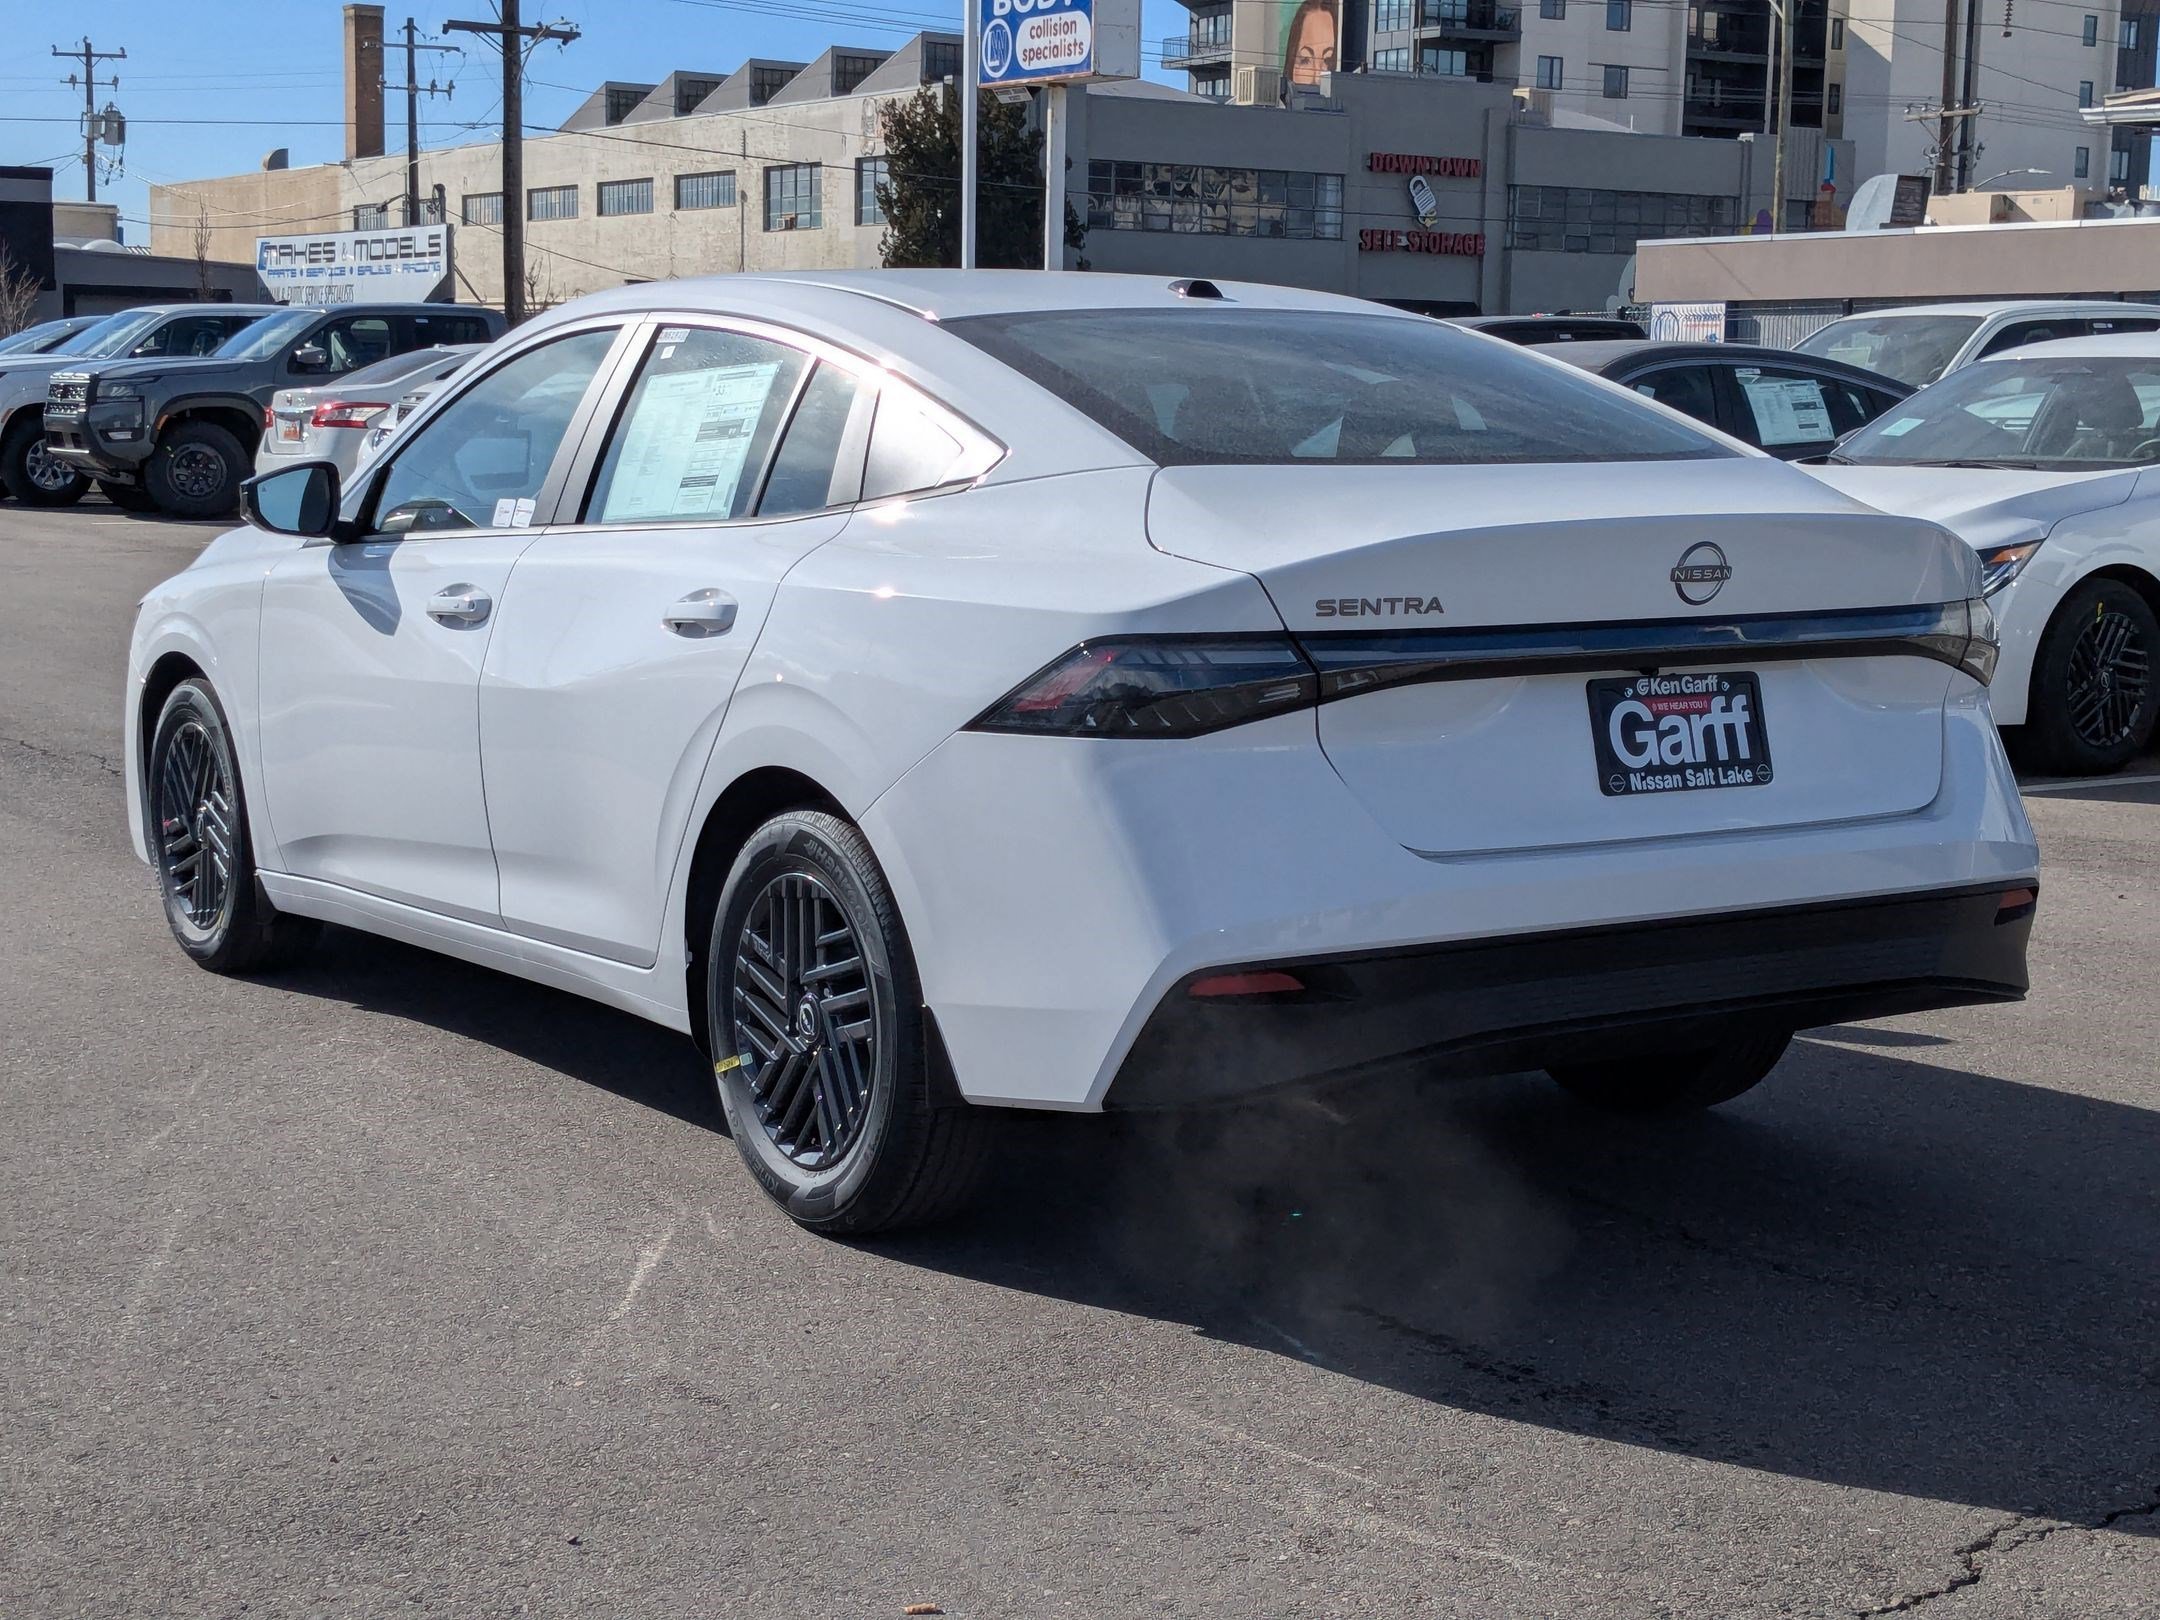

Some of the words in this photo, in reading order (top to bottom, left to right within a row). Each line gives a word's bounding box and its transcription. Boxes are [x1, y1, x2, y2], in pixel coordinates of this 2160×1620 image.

[1029, 17, 1077, 40] collision
[1022, 38, 1084, 66] specialists
[1370, 152, 1482, 177] DOWNTOWN
[264, 241, 337, 266] MAKES
[353, 233, 442, 263] MODELS
[1359, 229, 1402, 252] SELF
[1406, 230, 1486, 257] STORAGE
[267, 268, 297, 279] PARTS
[305, 266, 346, 278] SERVICE
[357, 264, 392, 276] SALES
[1672, 567, 1731, 582] NISSAN
[1315, 597, 1444, 617] SENTRA
[1650, 677, 1680, 696] Ken
[1681, 674, 1718, 695] Garff
[1609, 694, 1750, 769] Garff
[1629, 772, 1683, 791] Nissan
[1685, 768, 1716, 788] Salt
[1718, 765, 1753, 785] Lake
